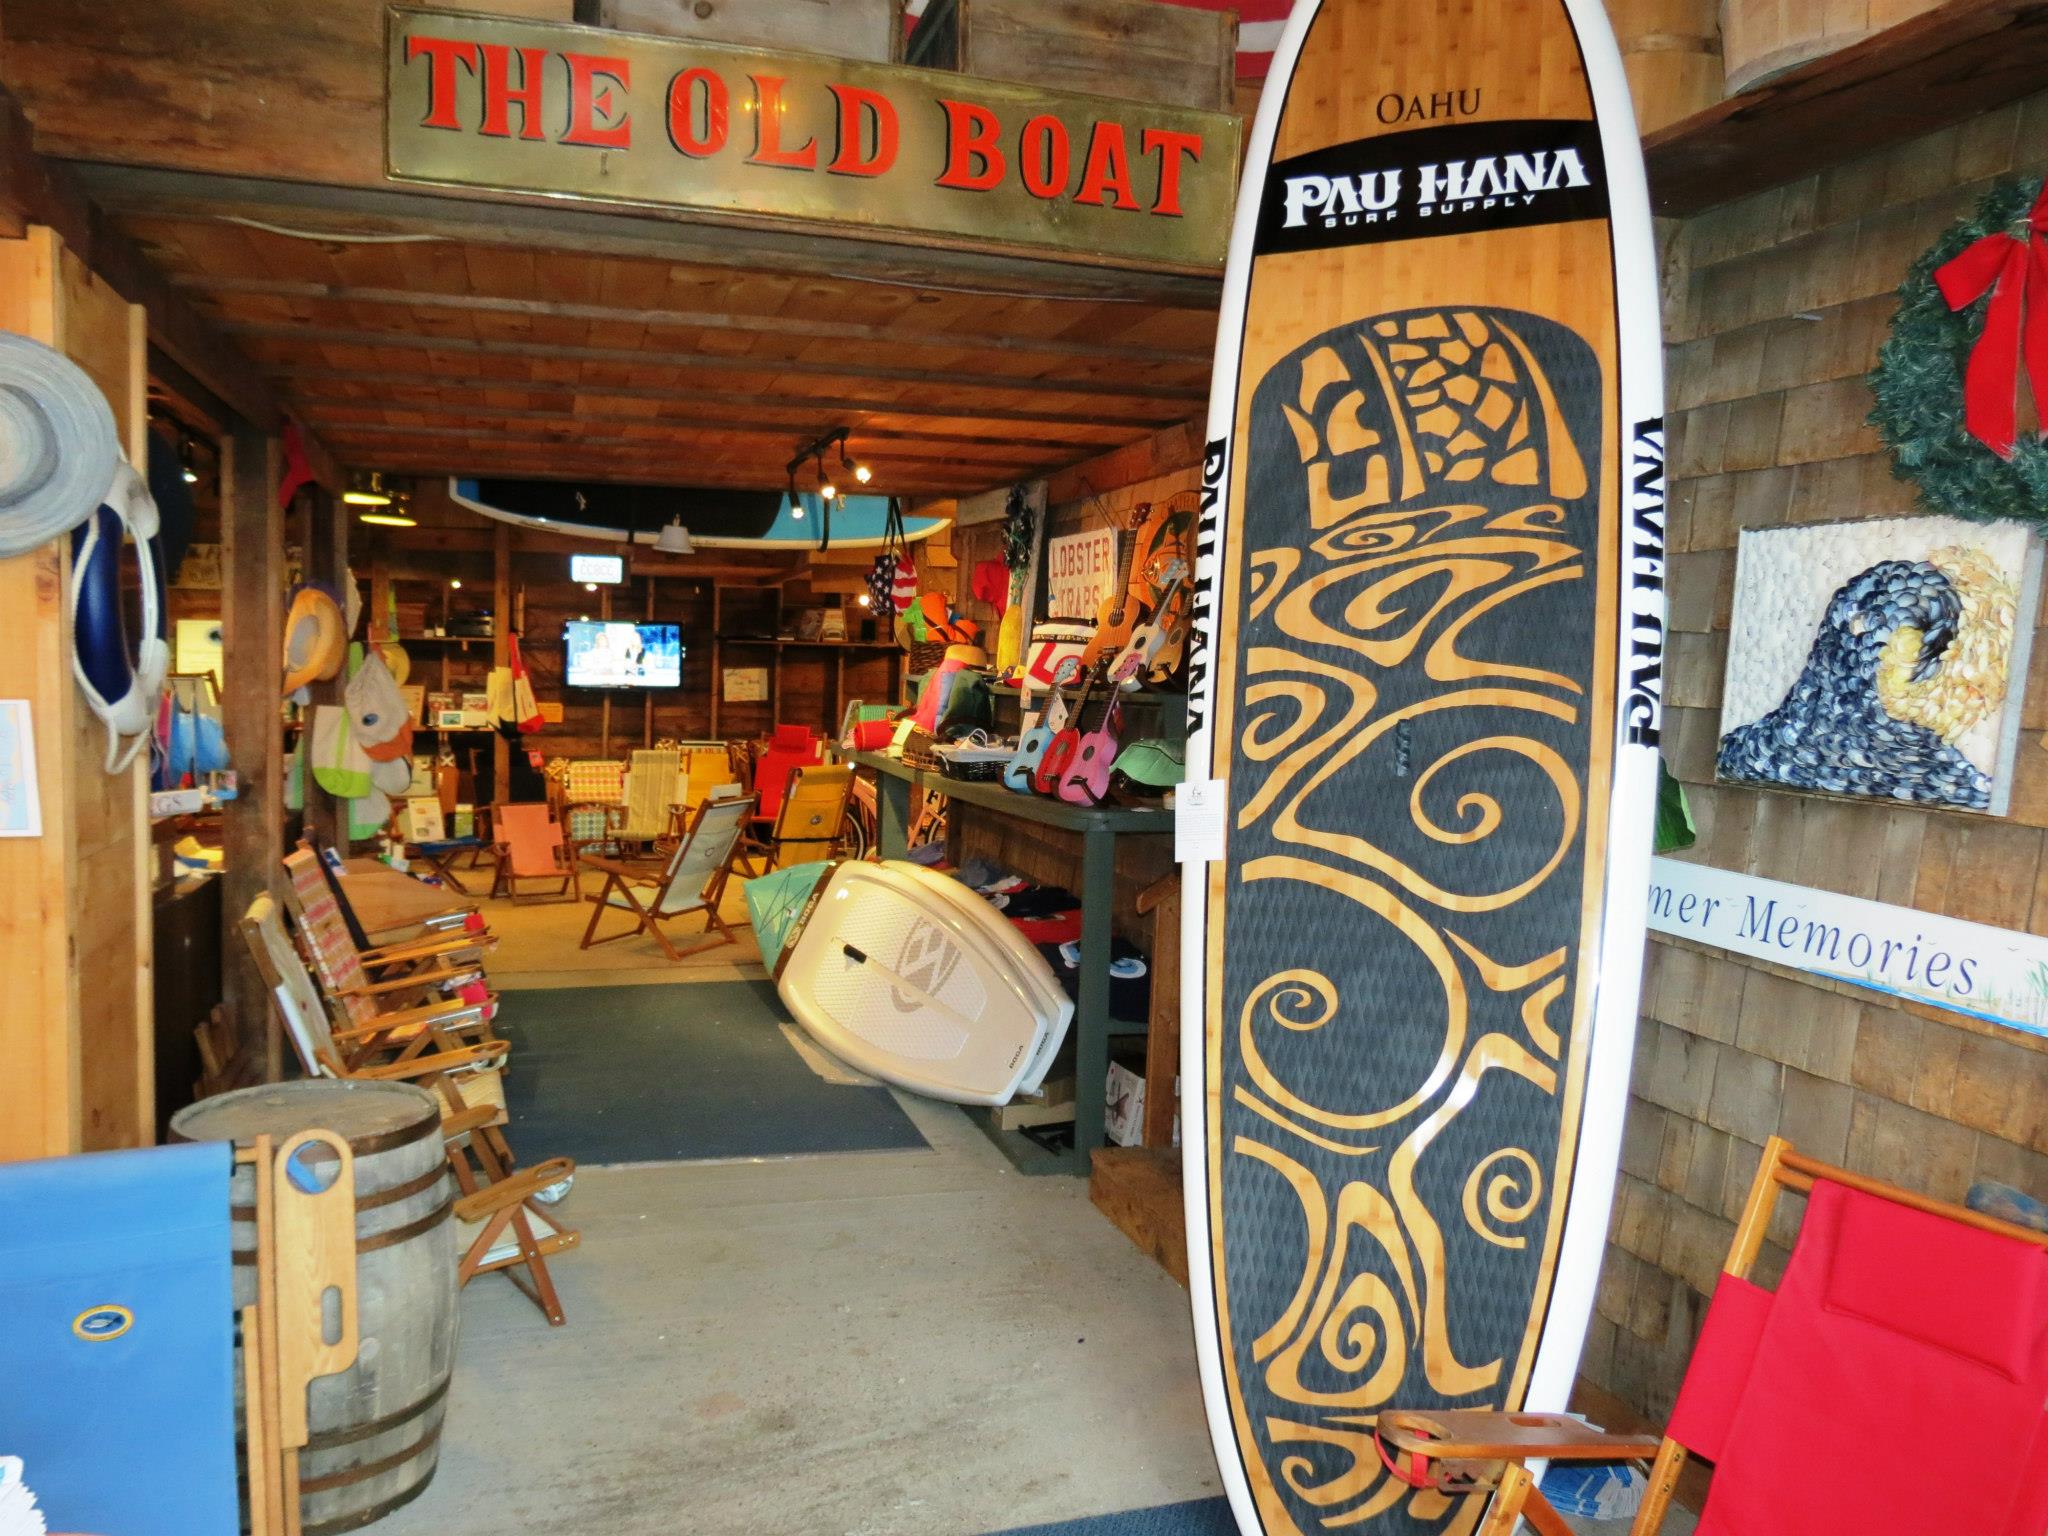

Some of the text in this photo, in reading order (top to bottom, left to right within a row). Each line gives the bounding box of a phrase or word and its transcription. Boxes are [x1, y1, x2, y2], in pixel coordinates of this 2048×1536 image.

[404, 35, 1202, 217] THE OLD BOAT
[1376, 87, 1481, 124] OAHU
[1282, 146, 1591, 229] PAU HANA
[1324, 194, 1537, 229] SURF SUPPLY
[1052, 537, 1109, 578] LOBSTER
[1625, 416, 1664, 750] PAU HANA
[1736, 894, 1979, 996] Memories
